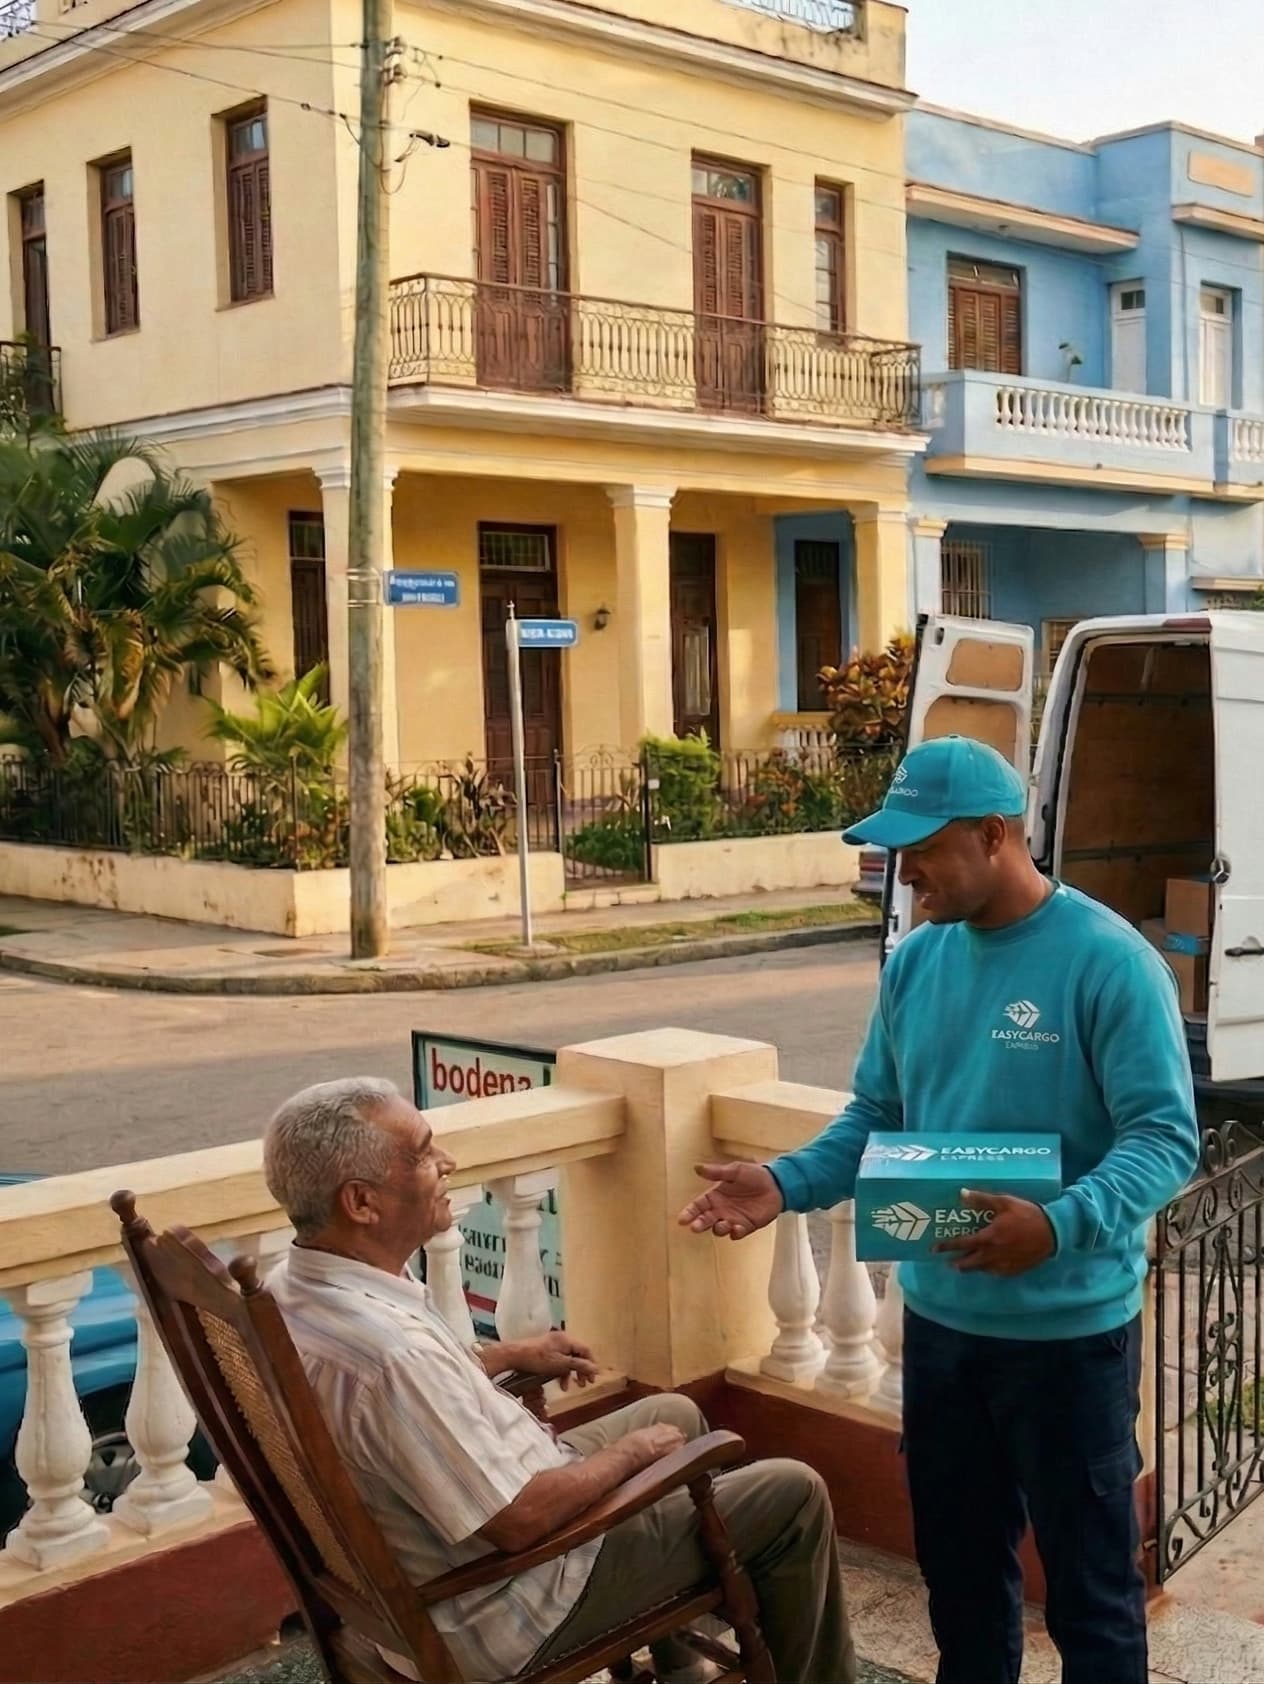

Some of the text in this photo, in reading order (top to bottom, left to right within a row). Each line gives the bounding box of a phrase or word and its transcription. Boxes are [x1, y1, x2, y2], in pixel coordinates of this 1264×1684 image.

[991, 1029, 1060, 1043] EASYCARGO
[940, 1146, 1052, 1155] EASYCARGO
[935, 1208, 995, 1224] EASYC
